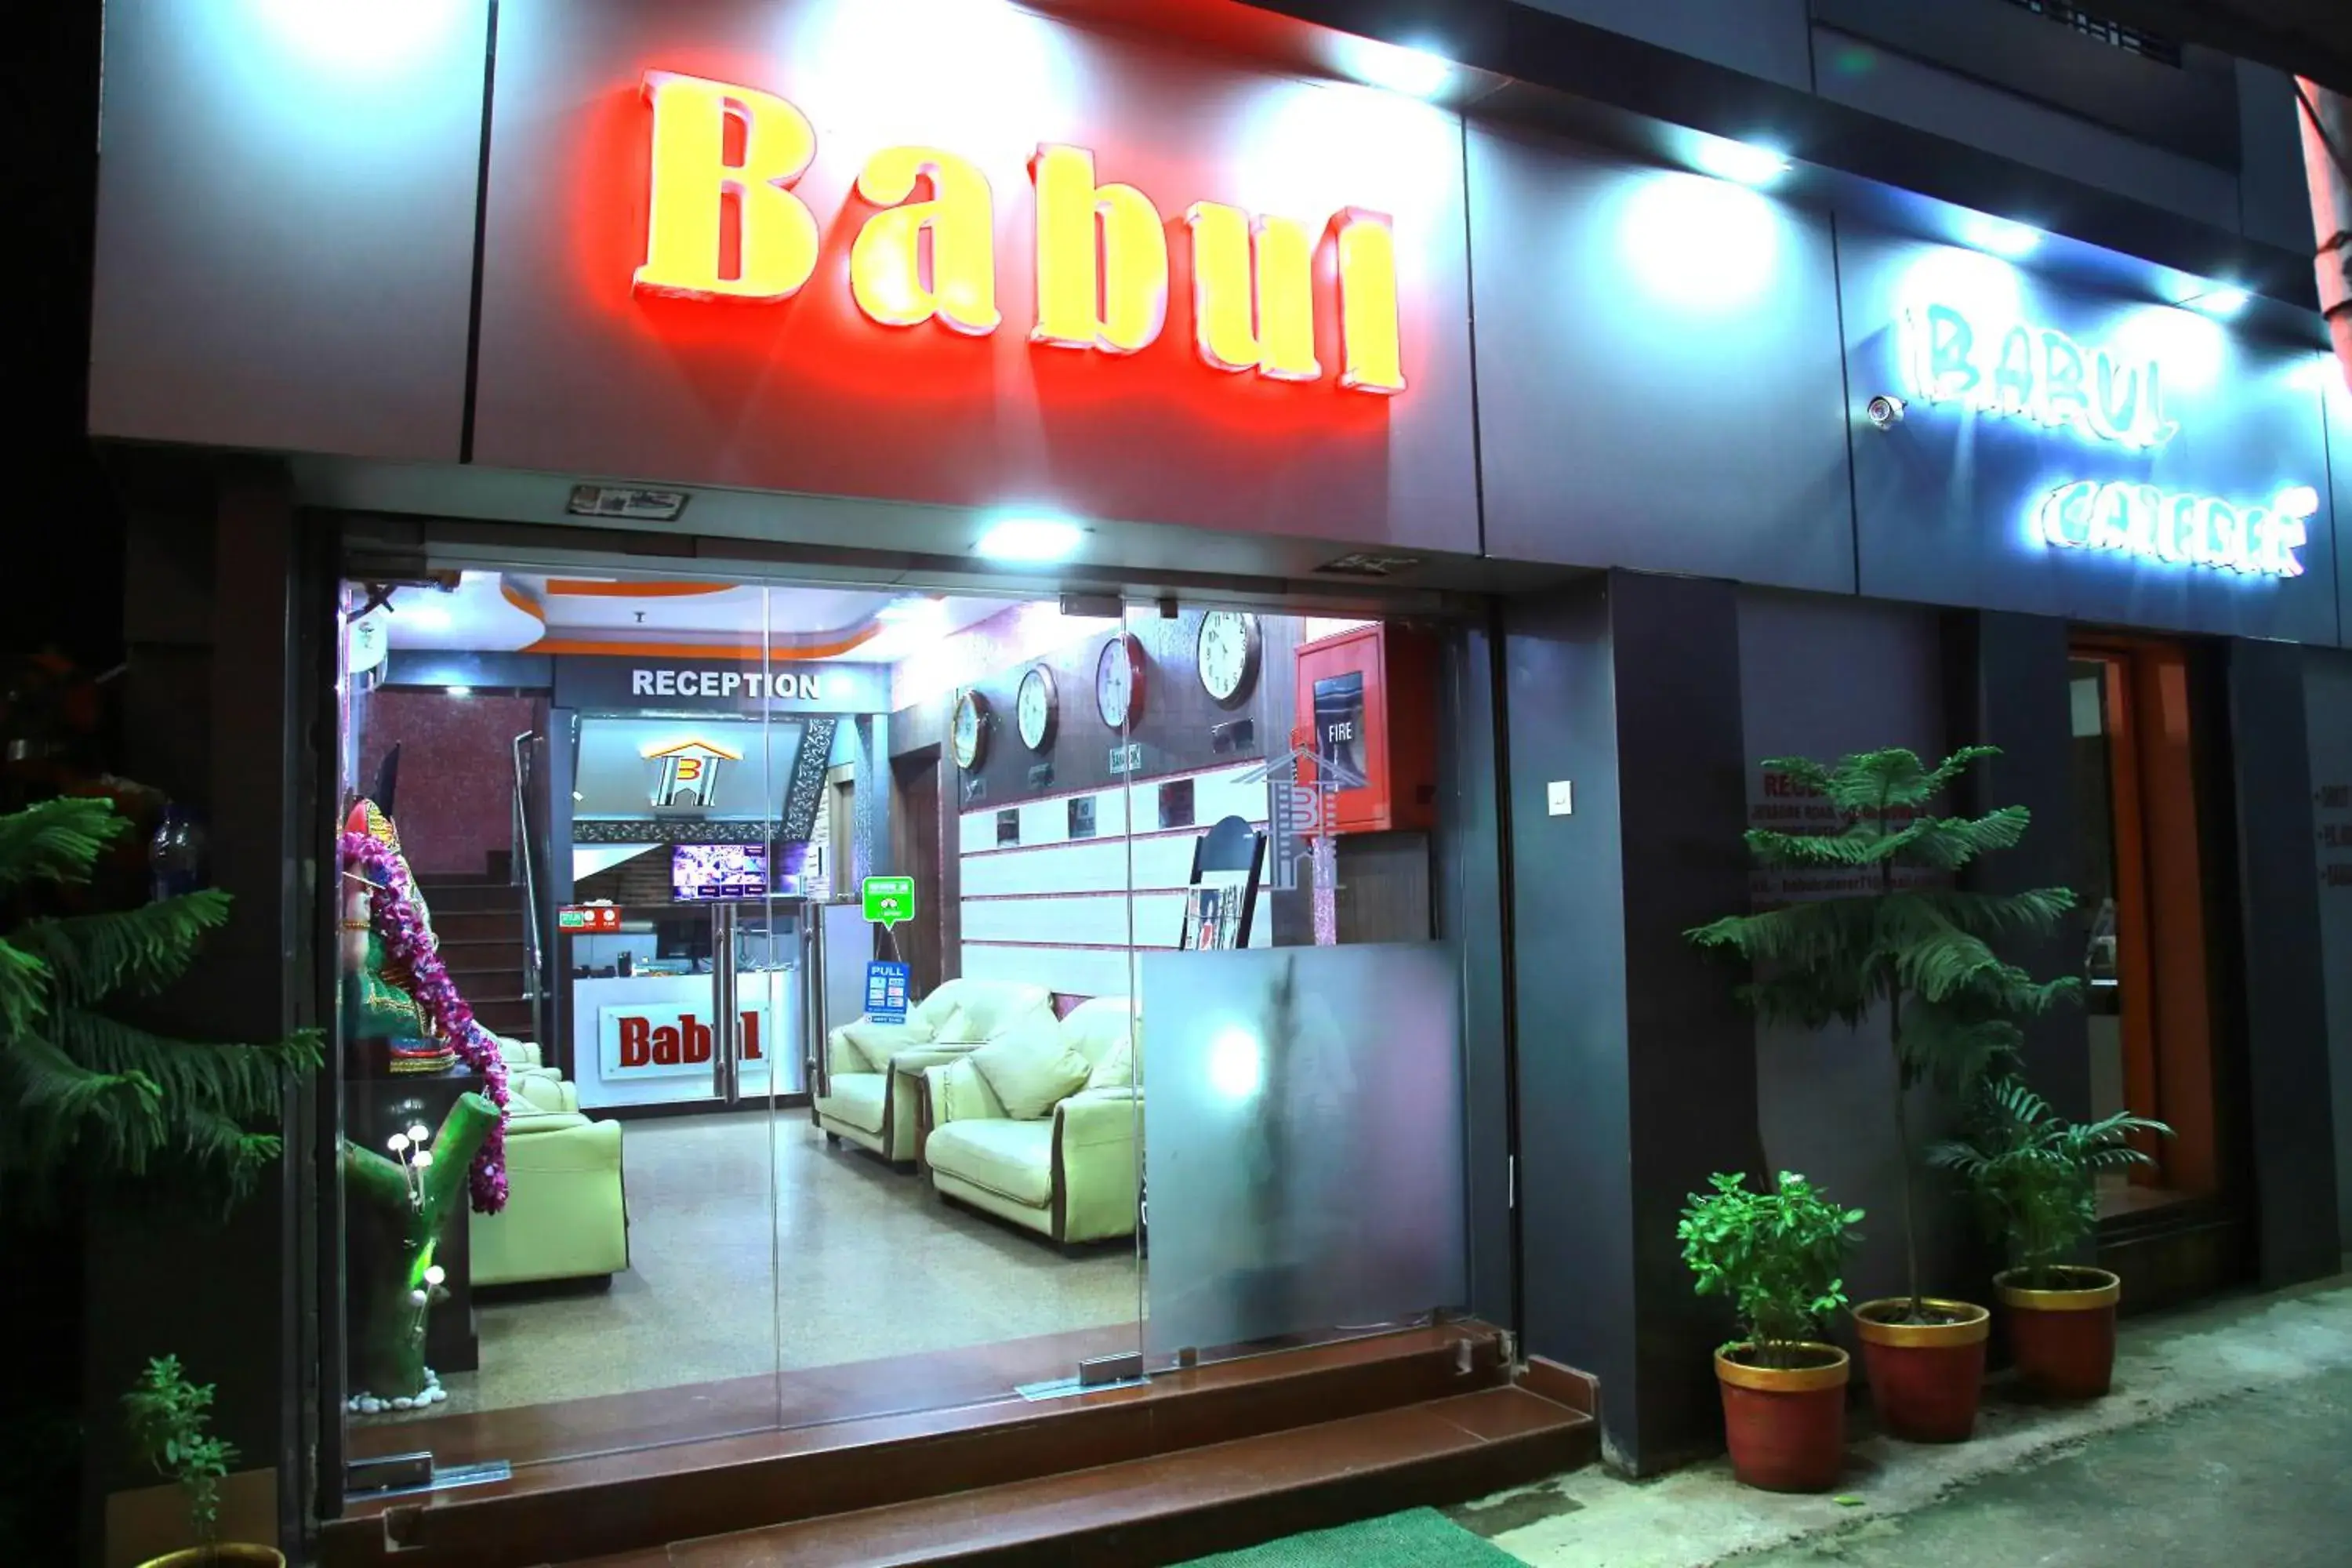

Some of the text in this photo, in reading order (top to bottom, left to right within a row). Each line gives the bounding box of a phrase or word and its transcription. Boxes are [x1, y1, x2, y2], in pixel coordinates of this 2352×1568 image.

[632, 69, 1408, 397] Babul
[1918, 300, 2180, 448] BABUL
[632, 669, 821, 699] RECEPTION
[1328, 721, 1353, 743] FIRE
[870, 966, 904, 977] PULL
